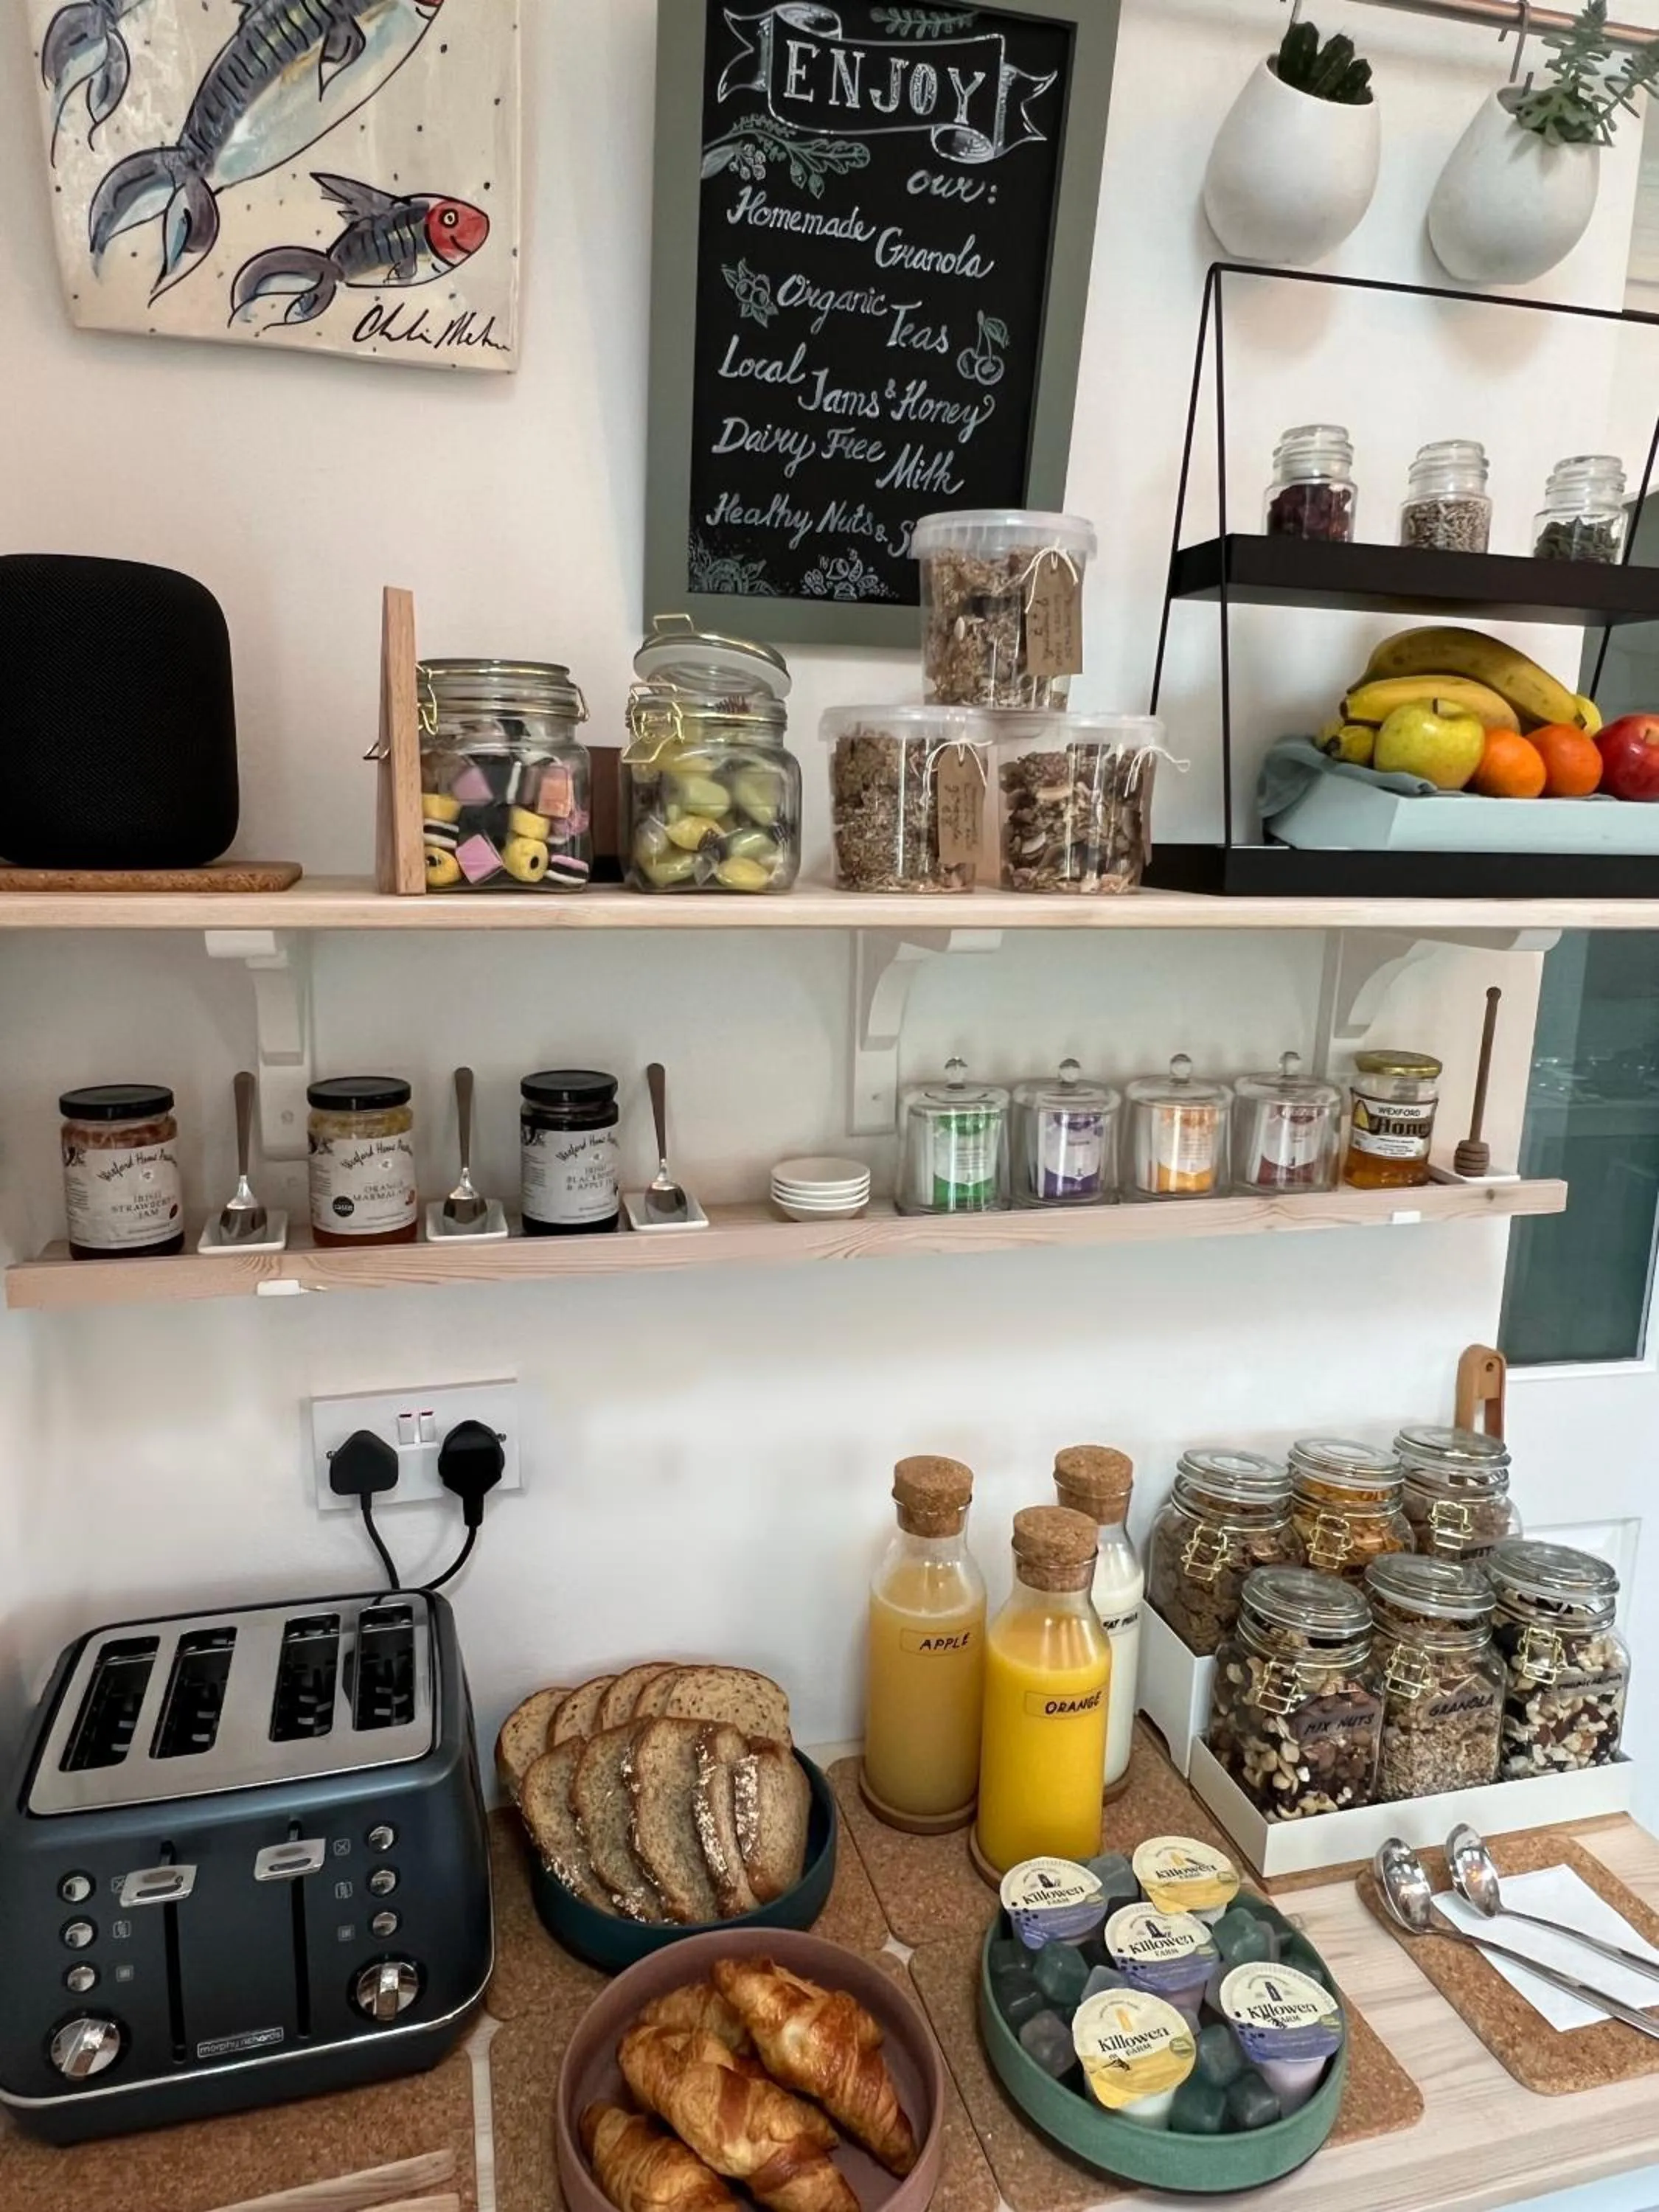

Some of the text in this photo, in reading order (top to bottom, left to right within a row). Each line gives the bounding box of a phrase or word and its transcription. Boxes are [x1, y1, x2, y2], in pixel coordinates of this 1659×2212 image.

[784, 40, 986, 125] ENJOY
[727, 187, 994, 279] Homemade Granola
[777, 275, 949, 354] Organic Teas
[718, 335, 995, 443] Local Jams & Honey
[712, 417, 964, 495] Dairy Free Milk
[706, 492, 813, 549] Healthy
[815, 500, 874, 535] Nuts
[874, 524, 888, 543] &
[919, 1632, 970, 1651] APPLE
[1045, 1691, 1102, 1715] ORANGE
[1429, 1694, 1495, 1717] GRANOLA
[1304, 1712, 1375, 1735] MIX NUTS
[1155, 1864, 1217, 1879] Killowen
[1022, 1885, 1085, 1905] Killowen
[1129, 1934, 1194, 1955] Killowen
[1154, 1947, 1179, 1957] FARM
[1246, 2003, 1318, 2023] Killowen
[1098, 2027, 1170, 2052] Killowen
[1125, 2042, 1152, 2056] FARM
